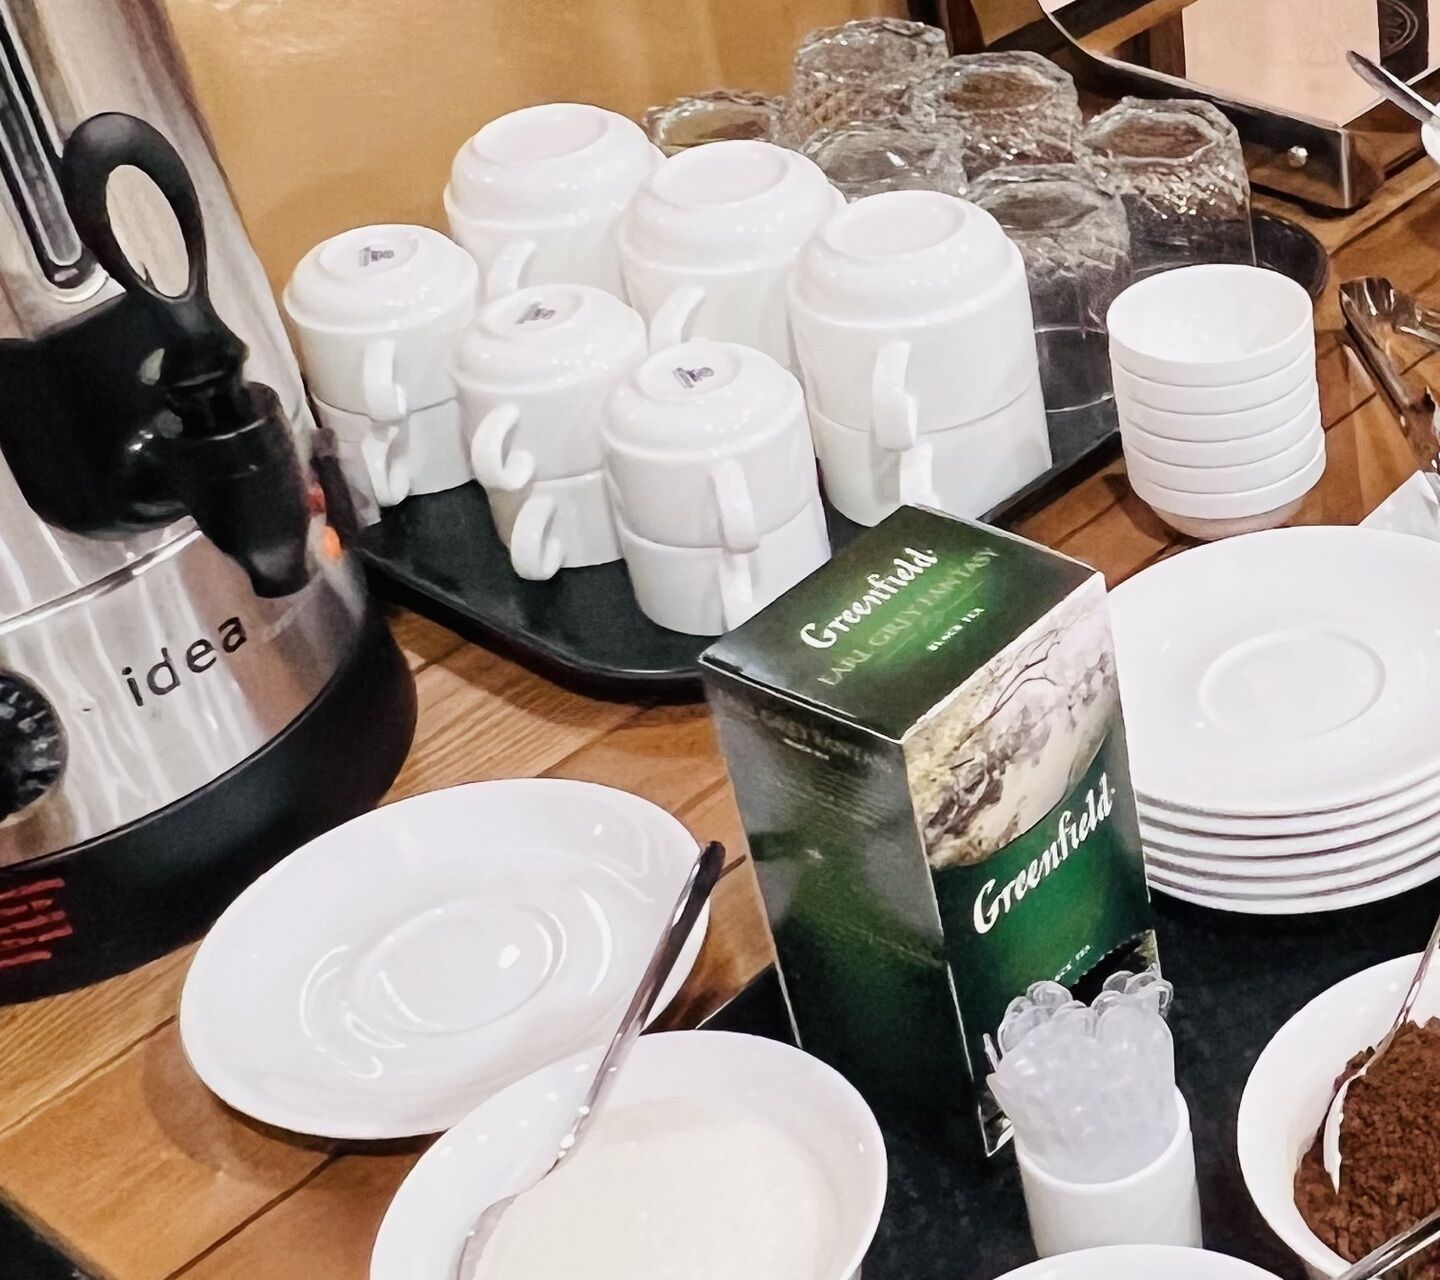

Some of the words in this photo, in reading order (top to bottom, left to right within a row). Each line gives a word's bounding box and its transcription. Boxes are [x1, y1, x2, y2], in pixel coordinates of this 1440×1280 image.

[800, 547, 939, 649] Greenfield
[121, 617, 248, 707] idea
[973, 772, 1116, 935] Greenfield
